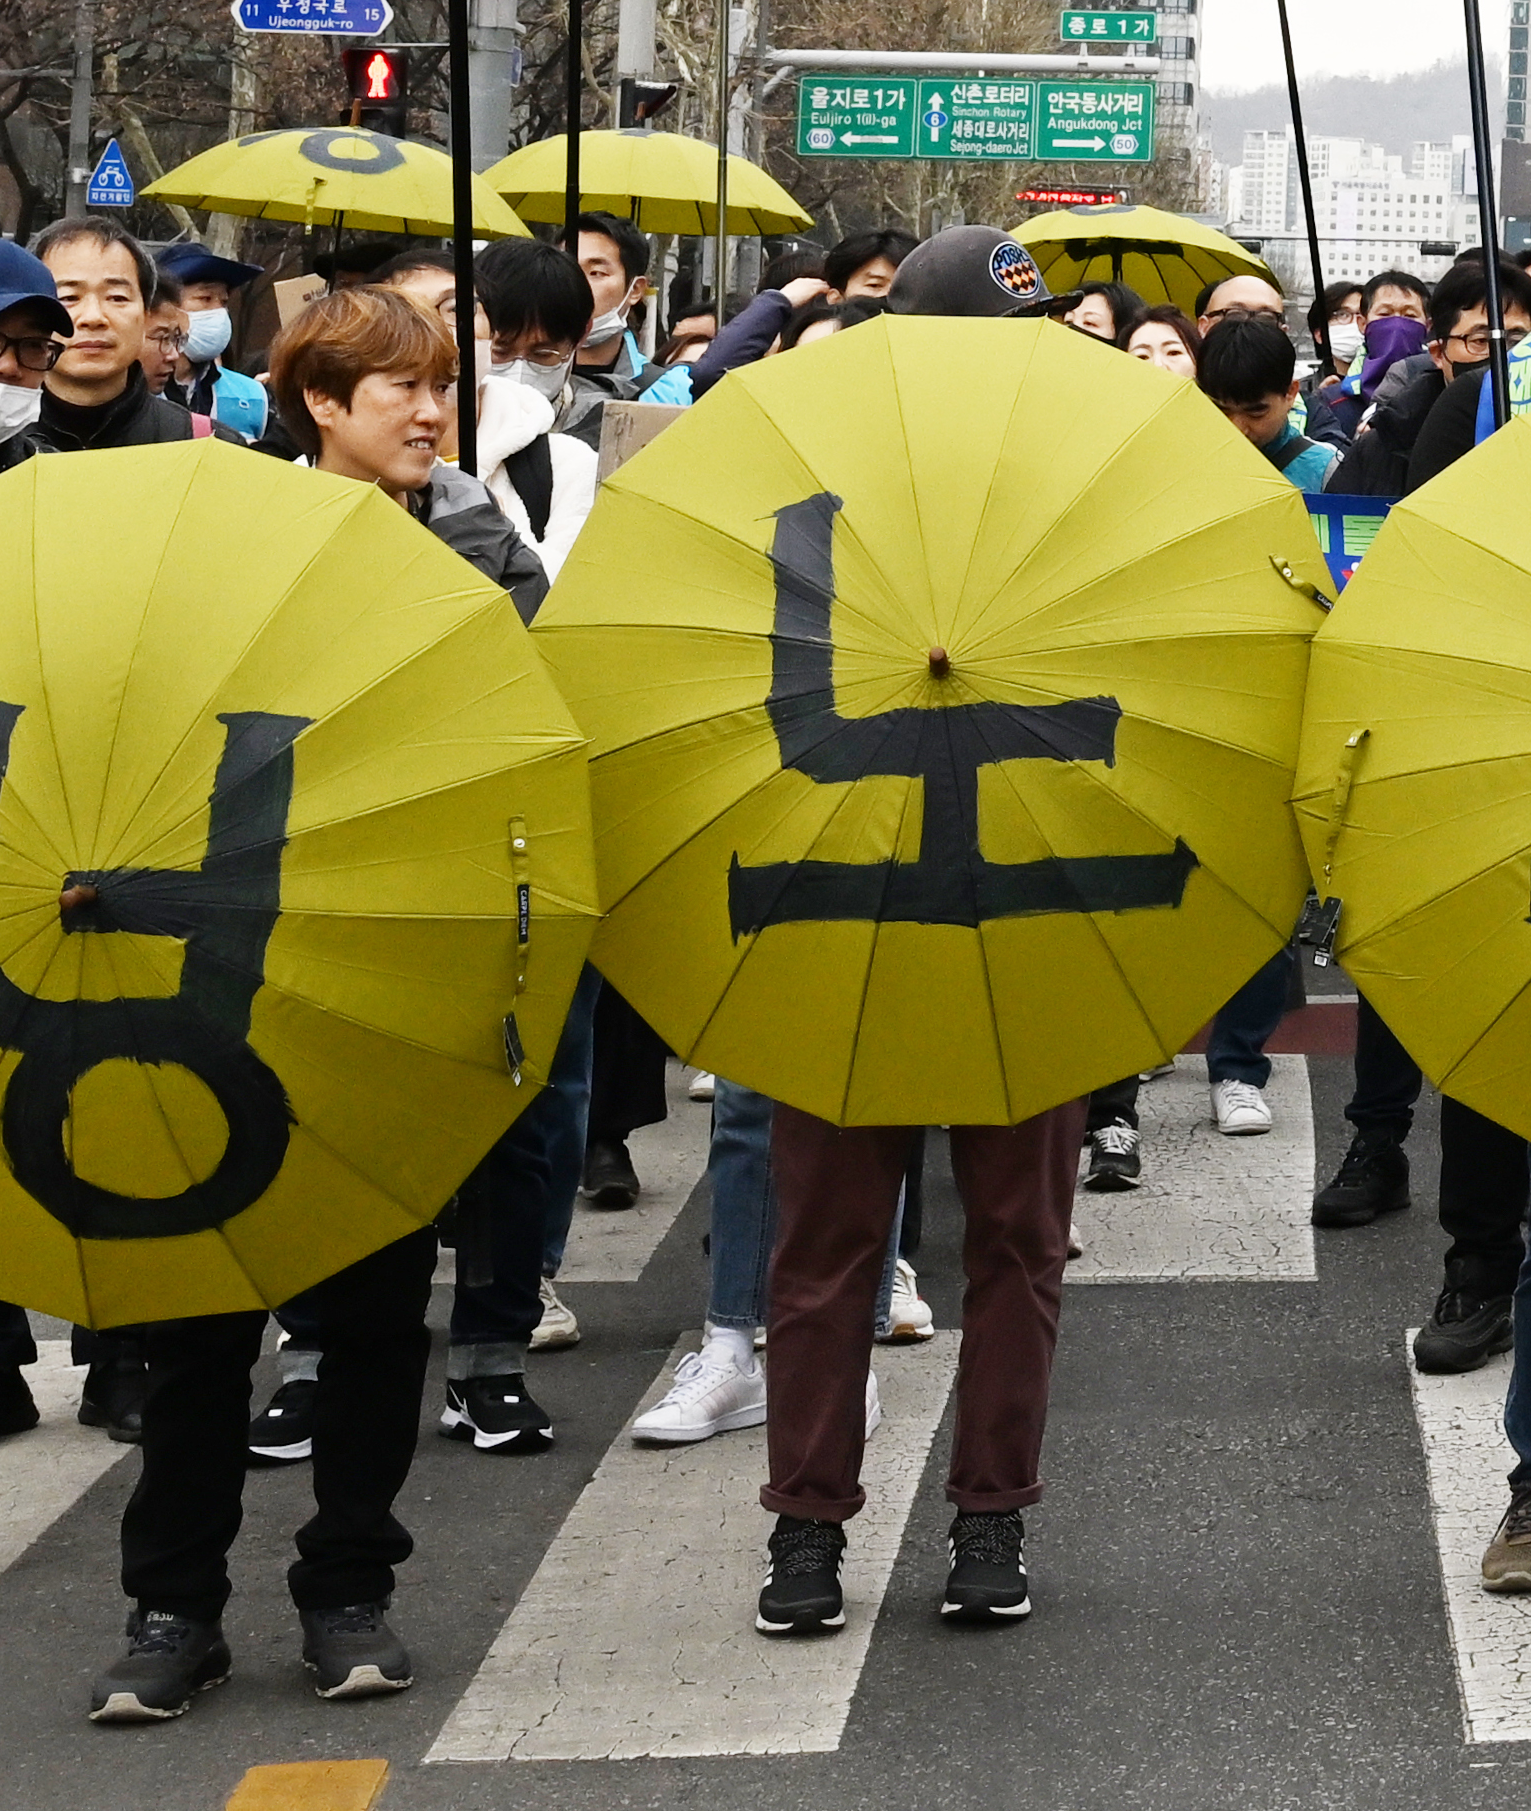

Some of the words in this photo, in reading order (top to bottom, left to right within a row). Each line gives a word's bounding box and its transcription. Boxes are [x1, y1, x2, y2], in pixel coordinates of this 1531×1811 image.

[245, 4, 259, 17] 11
[364, 6, 381, 21] 15
[268, 15, 354, 31] Ujeongguk-ro
[810, 87, 906, 111] 을지로1가
[950, 83, 1030, 107] 신촌로터리
[1047, 92, 1143, 116] 안국동사거리
[811, 111, 851, 128] Euljiro
[929, 112, 940, 126] 6
[951, 106, 989, 119] Sinchon
[993, 106, 1027, 120] Rotary
[950, 120, 1030, 140] 세종대로사거리
[1047, 115, 1119, 133] Angukdong
[1121, 118, 1143, 132] Jct
[812, 132, 830, 145] 60
[1116, 138, 1134, 151] 50
[949, 140, 1013, 156] Sejong-daero
[1013, 142, 1029, 156] Jct
